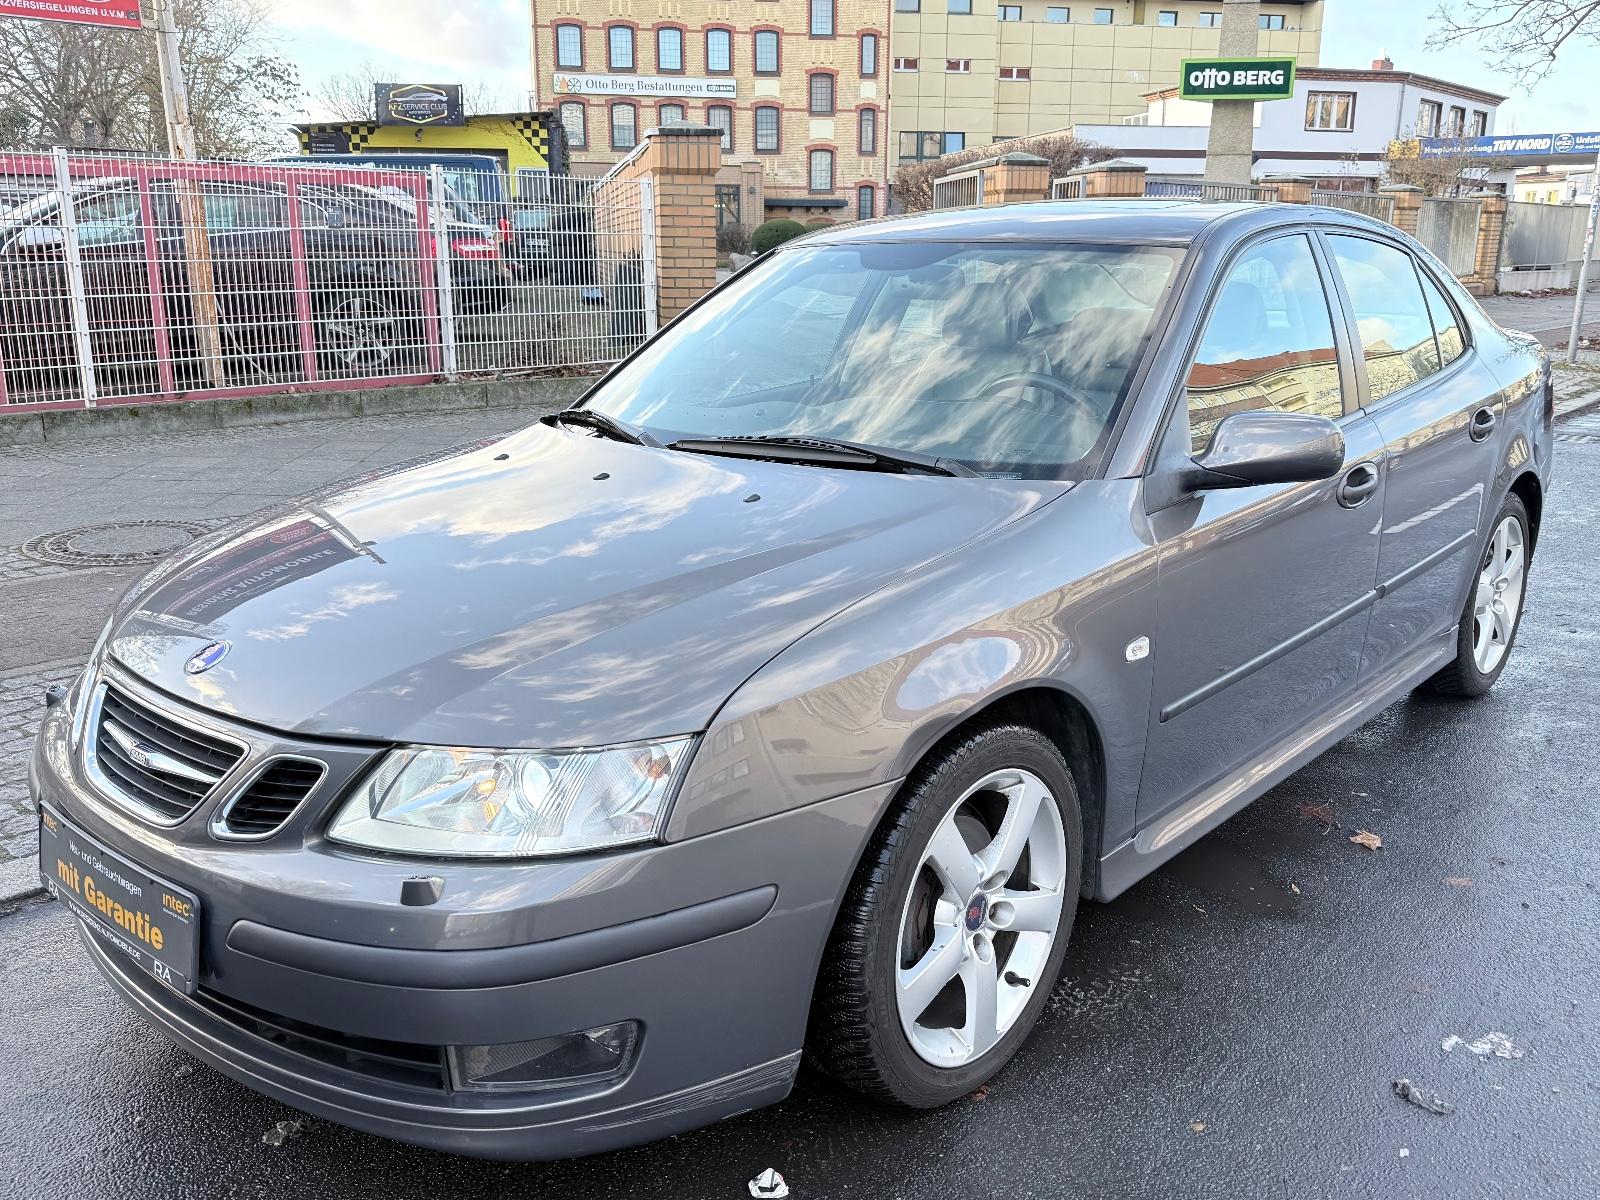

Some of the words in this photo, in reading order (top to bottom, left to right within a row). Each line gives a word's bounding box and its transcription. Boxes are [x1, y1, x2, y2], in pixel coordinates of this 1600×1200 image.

[100, 9, 128, 19] U.V.M.
[585, 79, 608, 90] Otto
[611, 80, 634, 93] Berg
[637, 80, 703, 94] Bestattungen
[1232, 69, 1284, 86] BERG
[1514, 138, 1551, 151] NORD
[81, 851, 92, 865] und
[92, 856, 142, 898] Gebrauchtwagen
[48, 879, 60, 901] RA
[57, 858, 80, 894] mit
[84, 875, 164, 950] Garantie
[162, 893, 189, 917] intec
[153, 959, 173, 984] RA
